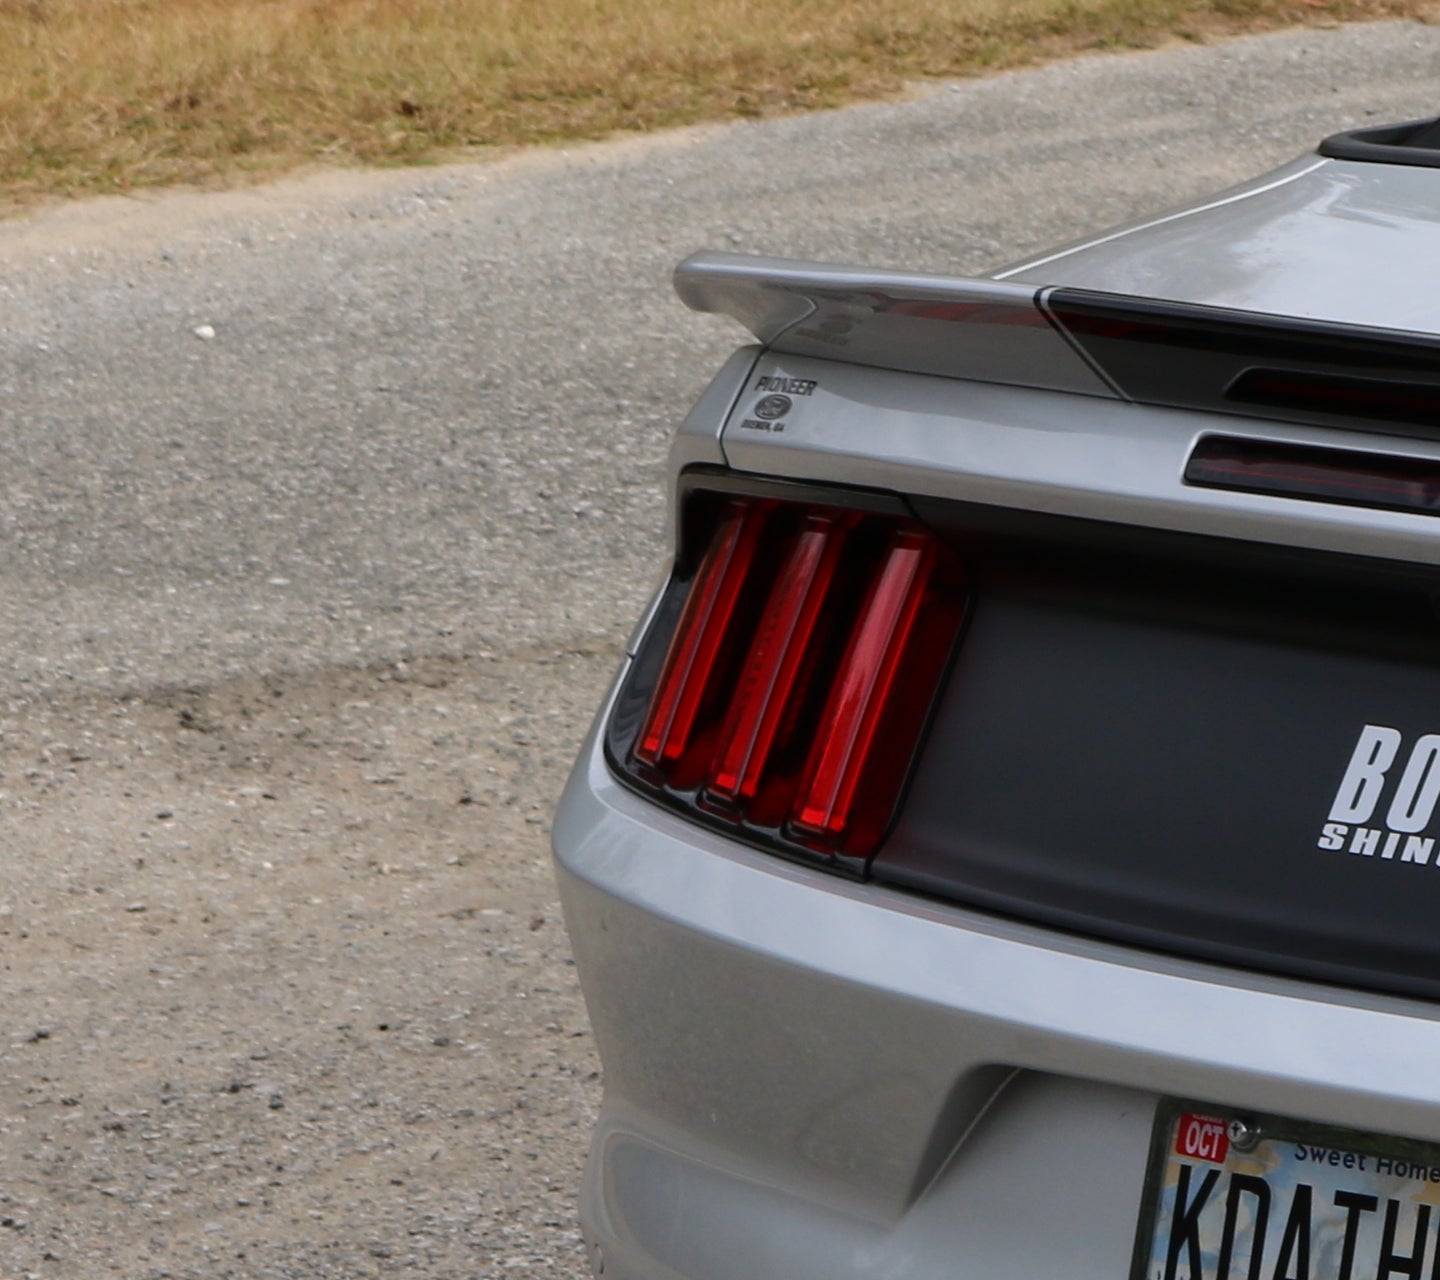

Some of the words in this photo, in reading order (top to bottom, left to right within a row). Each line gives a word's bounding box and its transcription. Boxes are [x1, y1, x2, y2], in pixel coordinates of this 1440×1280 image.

[755, 375, 817, 397] PIONEER
[1185, 1121, 1225, 1159] OCT
[1294, 1143, 1367, 1171] Sweet
